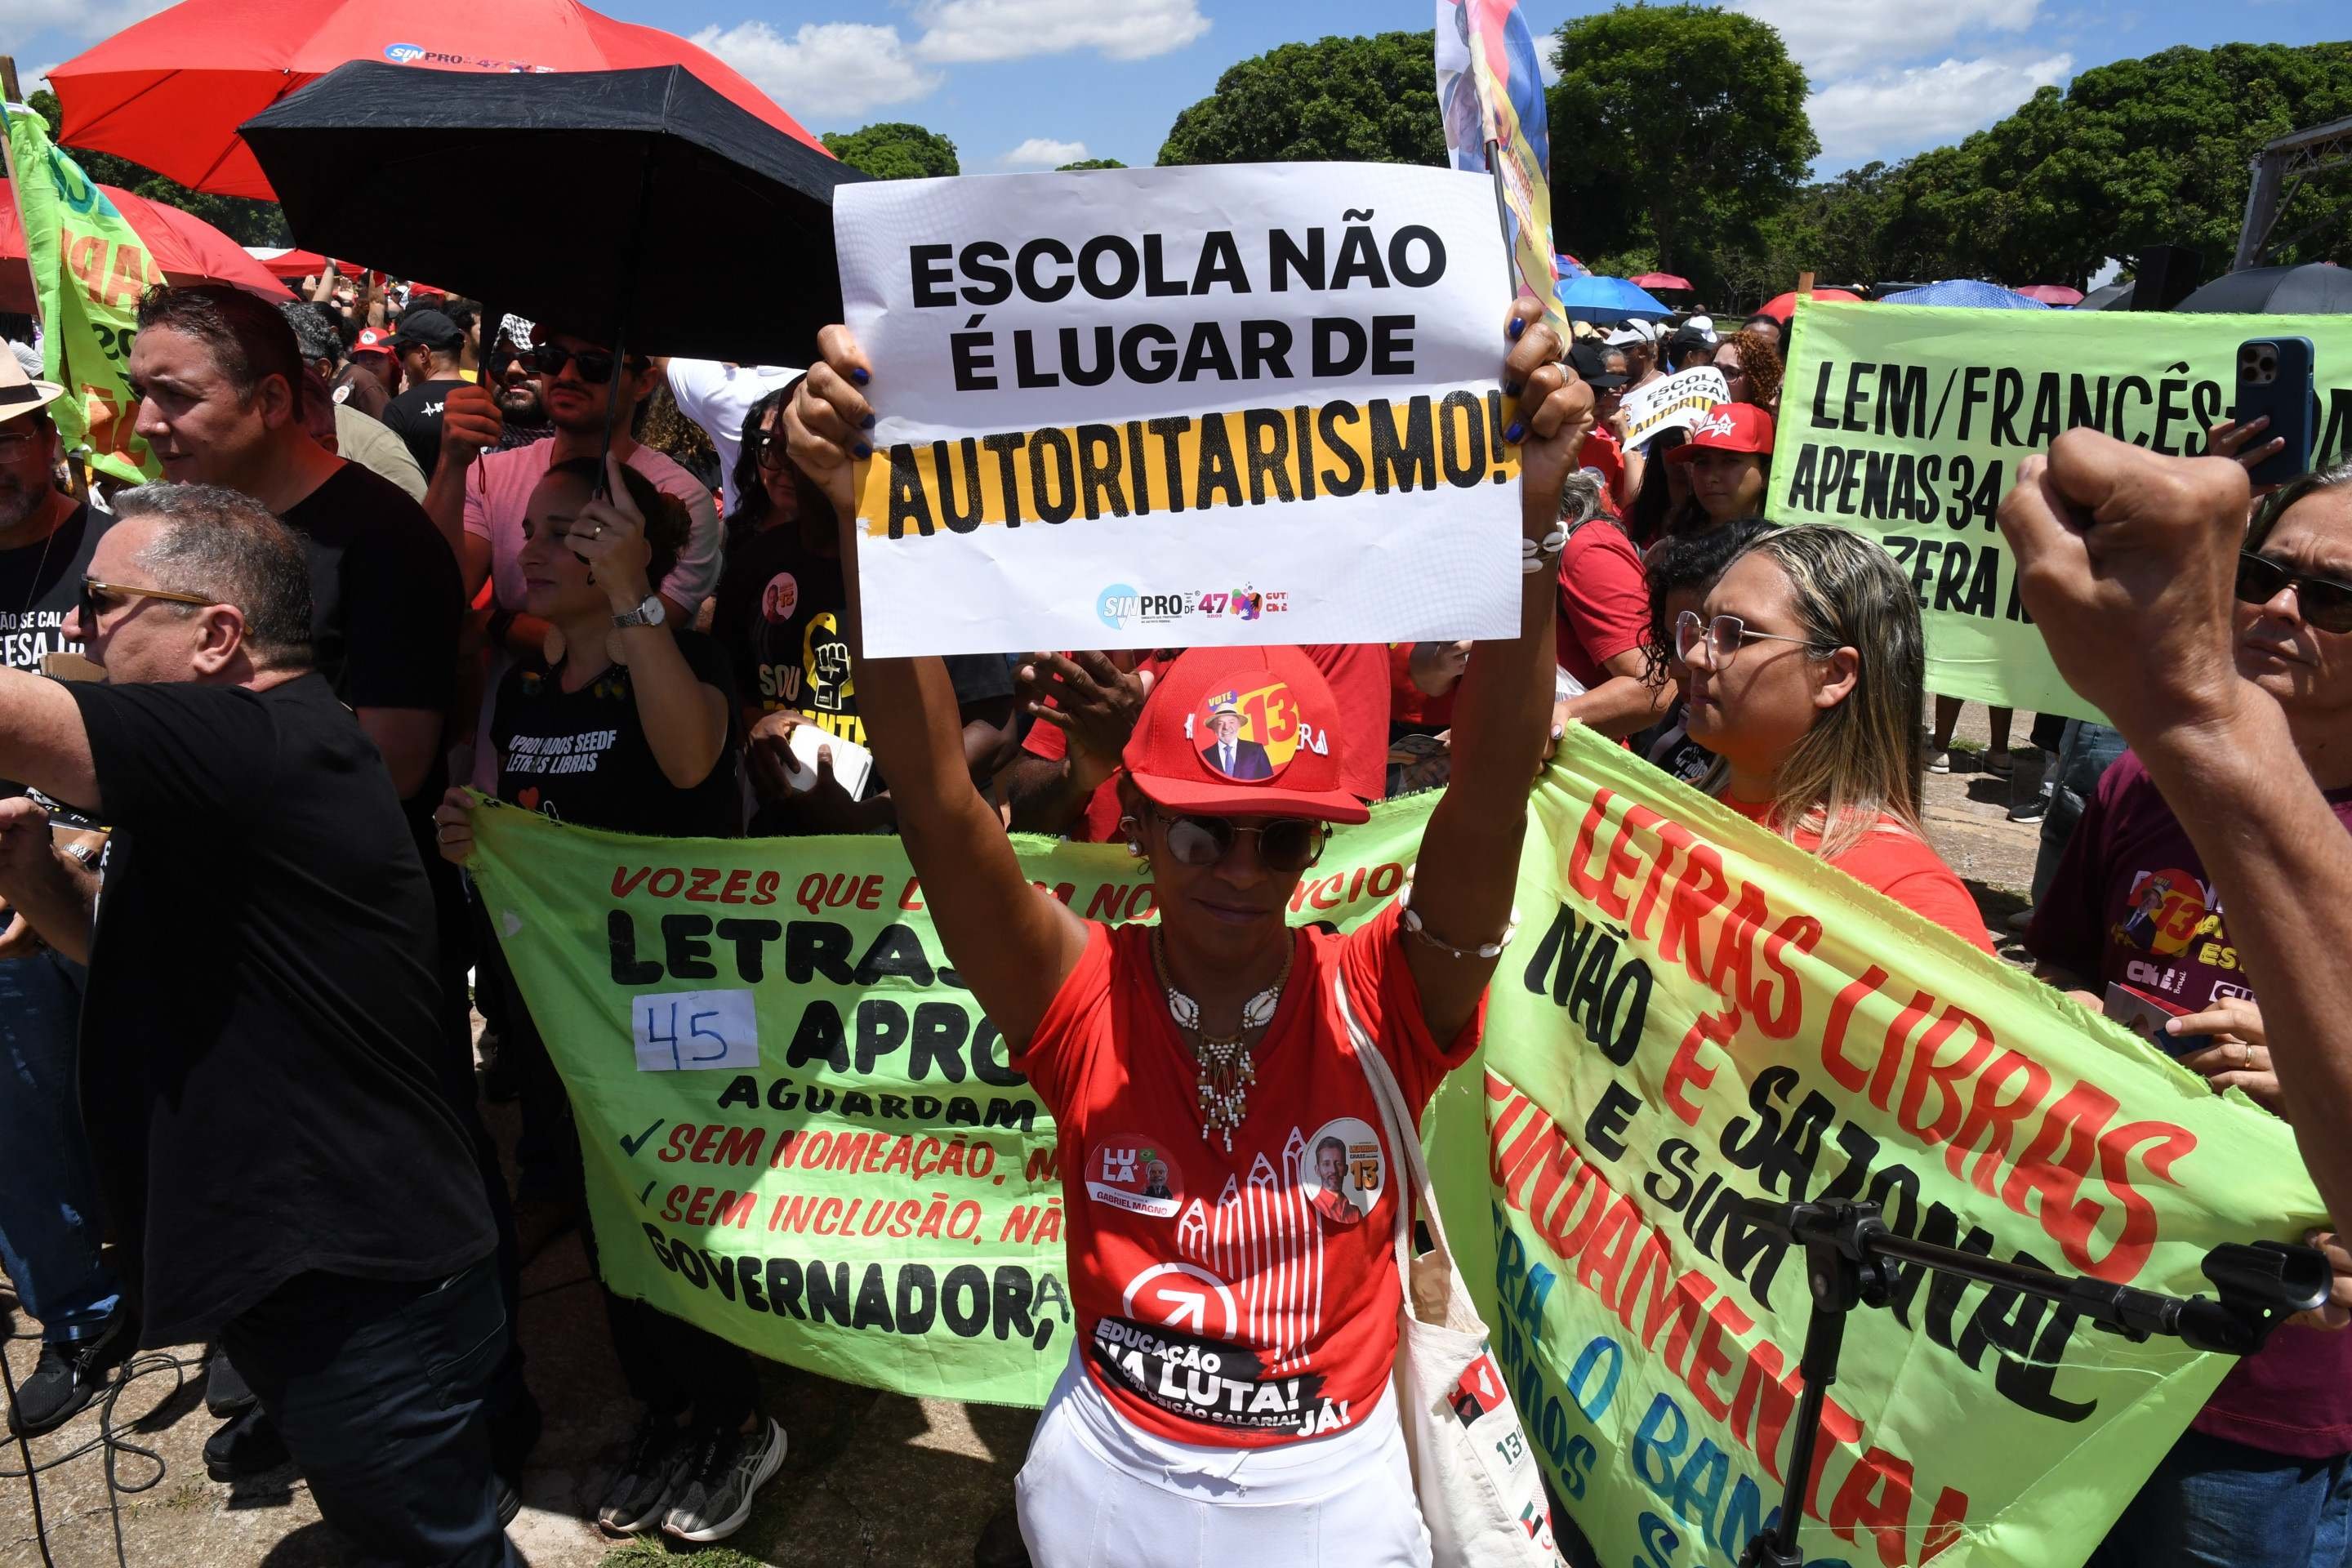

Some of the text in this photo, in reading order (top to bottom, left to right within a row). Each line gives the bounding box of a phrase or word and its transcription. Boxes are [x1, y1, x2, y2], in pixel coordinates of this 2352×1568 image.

[911, 208, 1447, 308] ESCOLA NÃO
[951, 314, 1416, 392] É LUGAR DE
[1646, 374, 1723, 401] ESCOLA
[888, 389, 1507, 540] AUTORITARISMO!
[1788, 443, 1943, 524] APENAS
[0, 611, 71, 630] ÃO SE CAL
[1103, 594, 1183, 617] SINPRO
[1198, 593, 1229, 614] 47
[0, 632, 48, 668] ESA
[759, 663, 801, 702] SOU
[1208, 691, 1232, 707] VOTE
[574, 729, 617, 753] SEEDF
[1243, 687, 1298, 746] 13
[549, 752, 599, 773] LIBRAS
[610, 866, 780, 906] VOZES
[796, 872, 884, 915] QUE
[2154, 896, 2207, 941] 13
[2198, 942, 2245, 973] ES
[1523, 901, 1654, 1067] NÃO
[648, 1001, 728, 1071] 45
[1568, 787, 2198, 1285] LETRAS LIBRAS
[718, 1075, 1037, 1133] AGUARDAM
[657, 1123, 764, 1169] SEM
[1350, 1160, 1379, 1191] 13
[1584, 1079, 1792, 1310] E SIM
[661, 1184, 757, 1230] SEM
[1000, 1196, 1067, 1245] NÃ
[1097, 1192, 1132, 1208] GABRIEL
[1133, 1202, 1168, 1215] MAGNO
[1096, 1318, 1222, 1374] EDUCAÇÃO
[1158, 1361, 1300, 1414] LUTA!
[1567, 1335, 1624, 1424] O
[1211, 1411, 1301, 1427] SALARIAL
[1296, 1397, 1352, 1437] JÁ!
